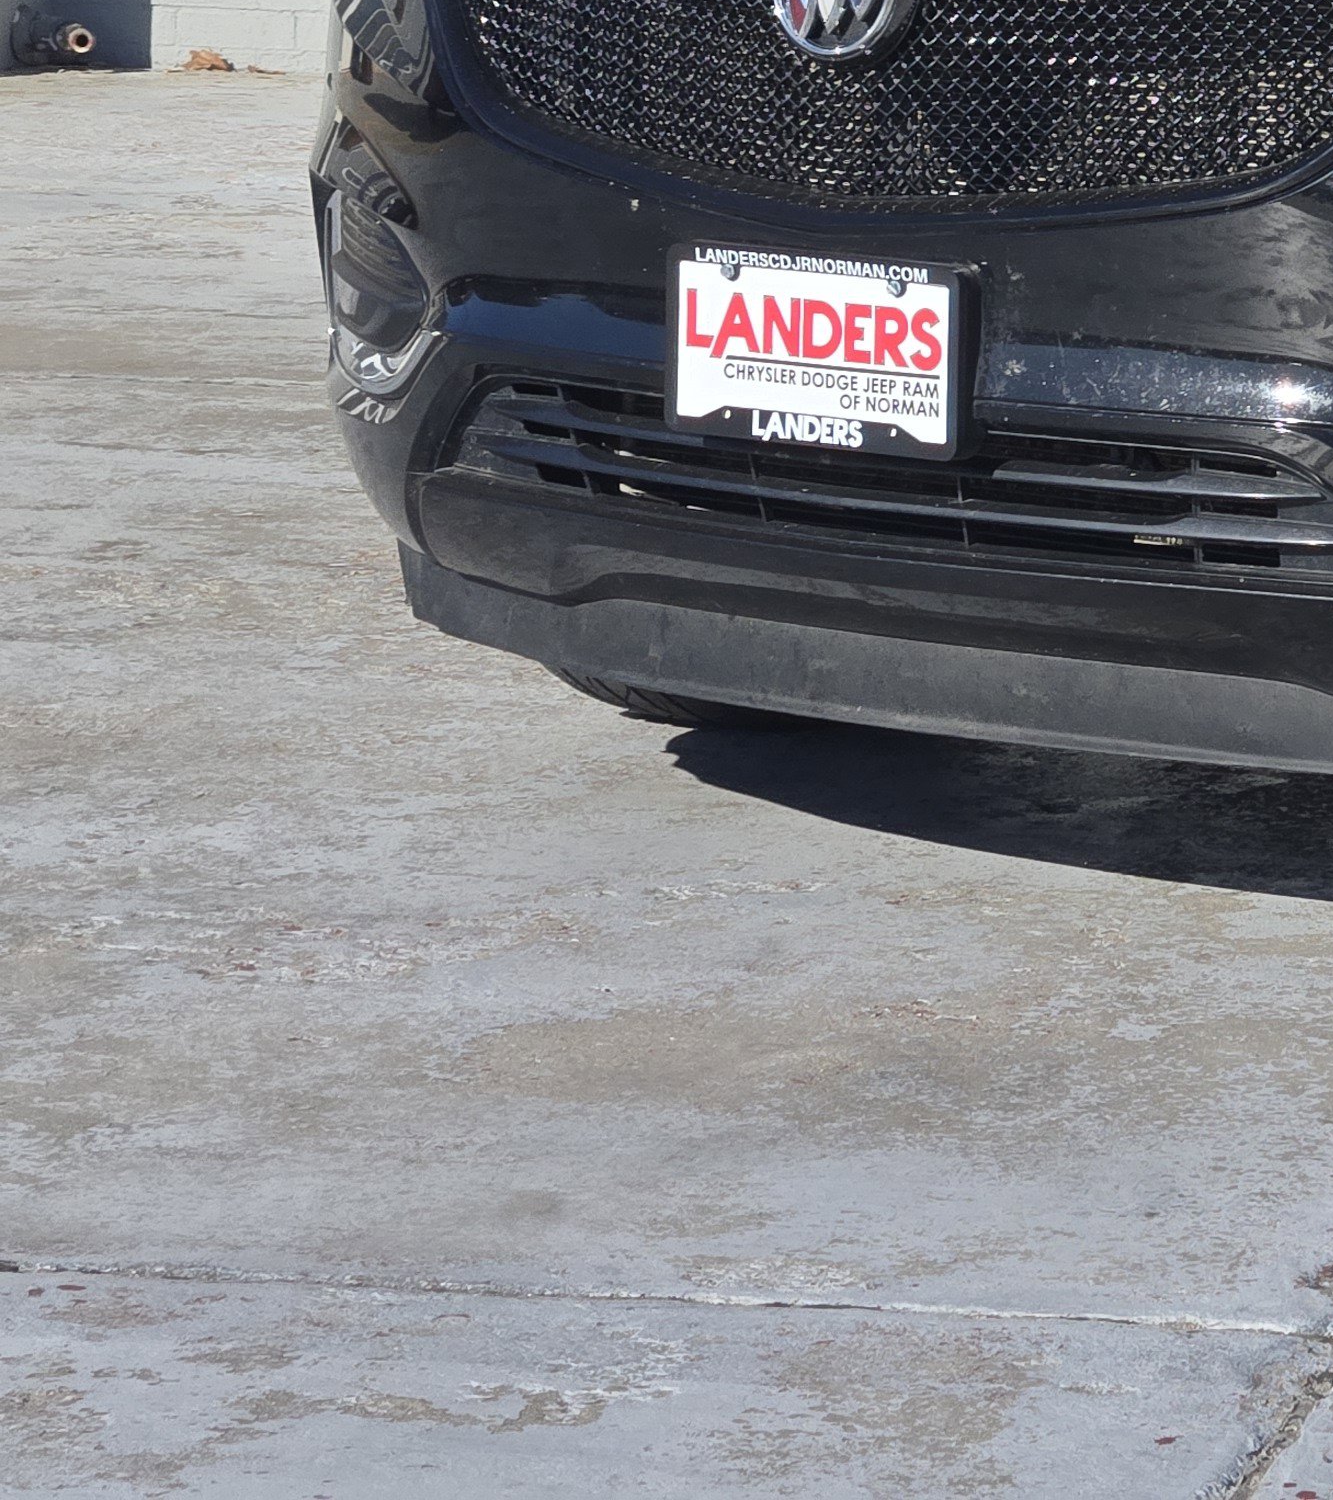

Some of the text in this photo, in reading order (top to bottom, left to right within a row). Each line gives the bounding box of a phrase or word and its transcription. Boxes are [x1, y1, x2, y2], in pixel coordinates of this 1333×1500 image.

[695, 247, 929, 284] LANDERSCDJRNORMAN.COM
[685, 288, 943, 372] LANDERS
[723, 363, 940, 400] CHRYSLER DODGE JEEP RAM
[839, 394, 940, 419] OF NORMAN
[751, 410, 864, 449] LANDERS
